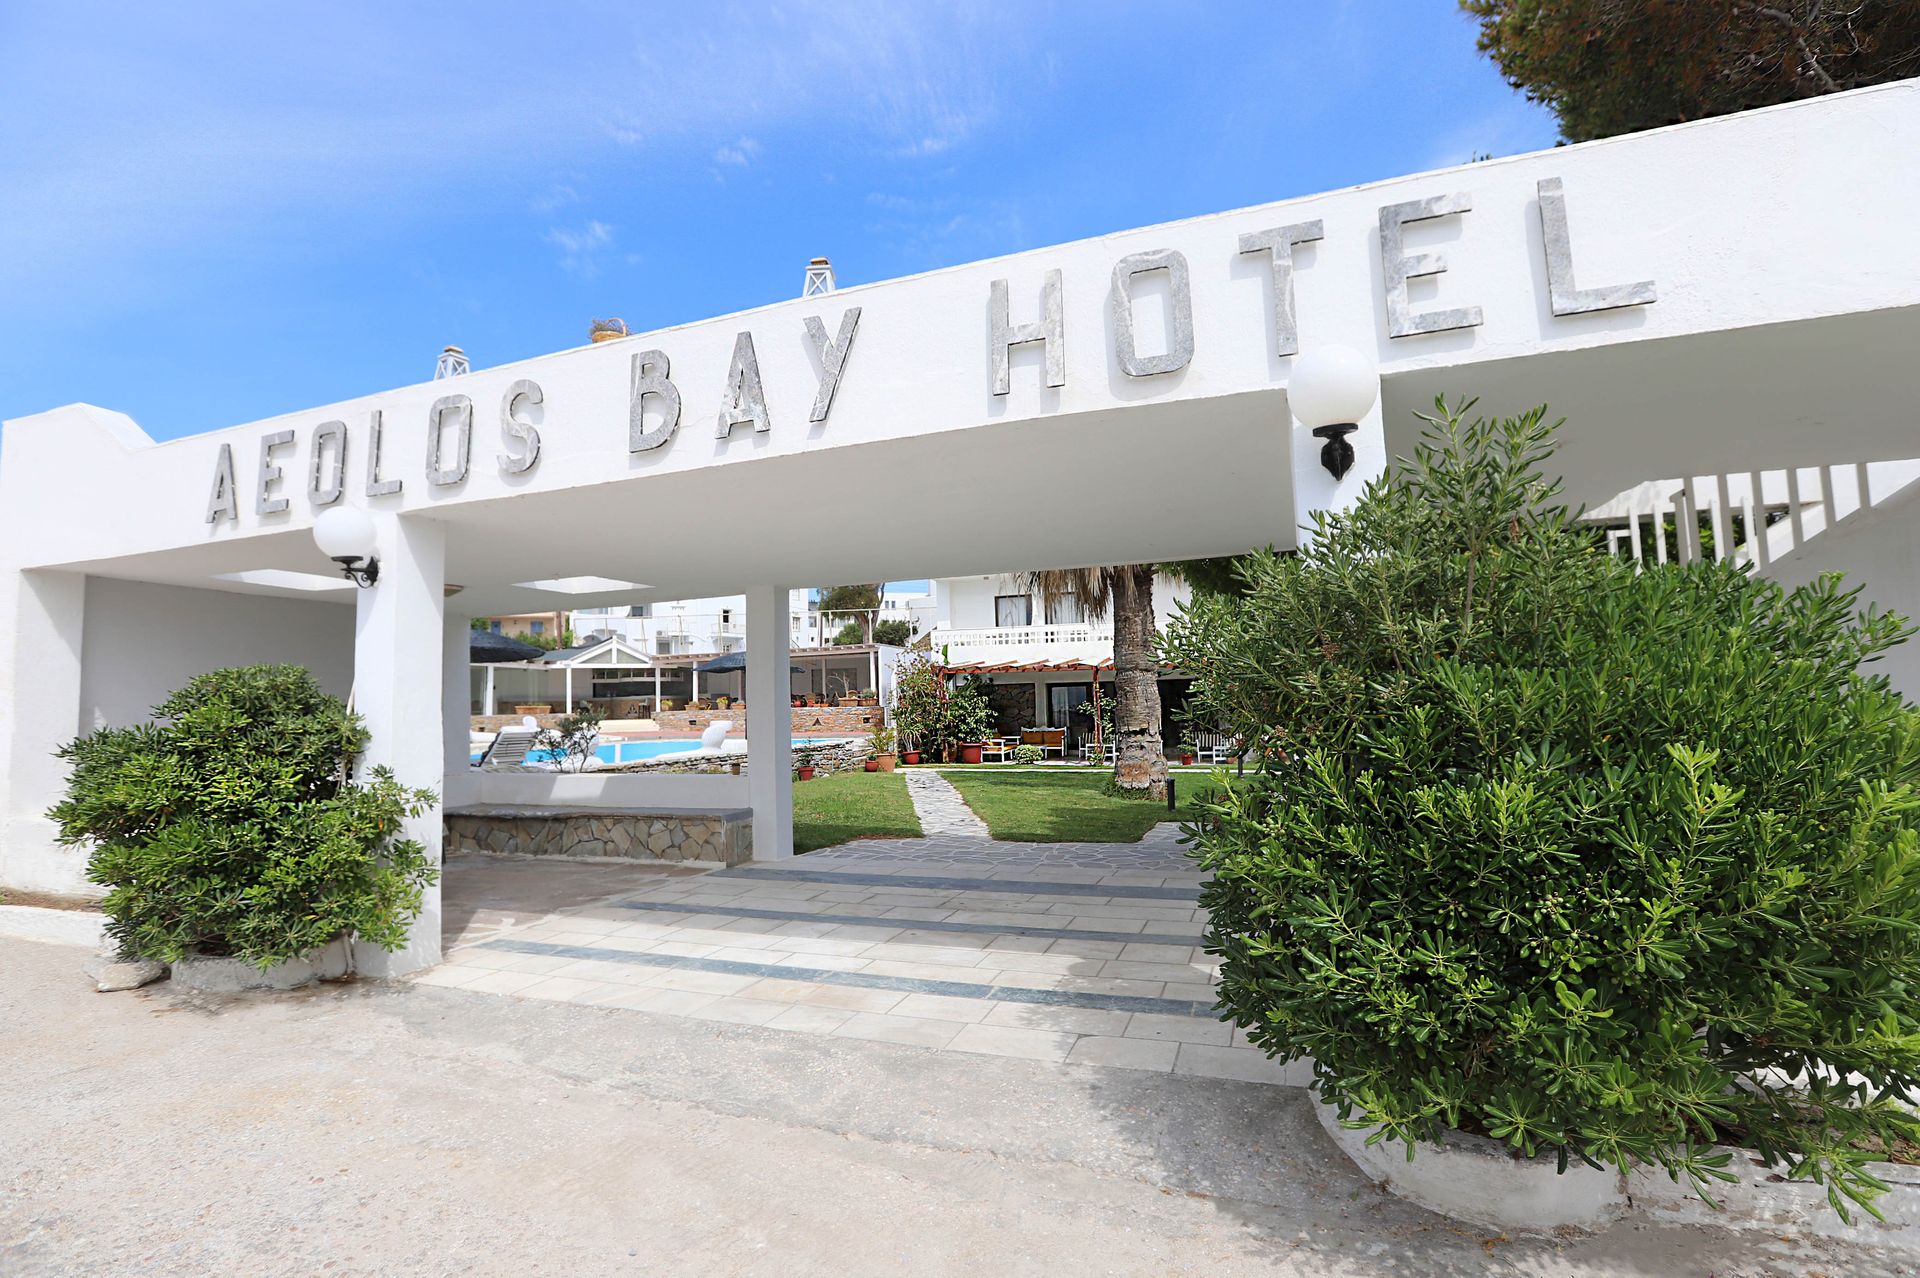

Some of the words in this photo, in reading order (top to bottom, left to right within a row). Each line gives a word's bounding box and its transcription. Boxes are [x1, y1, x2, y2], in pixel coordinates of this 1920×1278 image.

[206, 379, 544, 524] AEOLOS
[629, 306, 863, 454] BAY
[990, 176, 1657, 396] HOTEL
